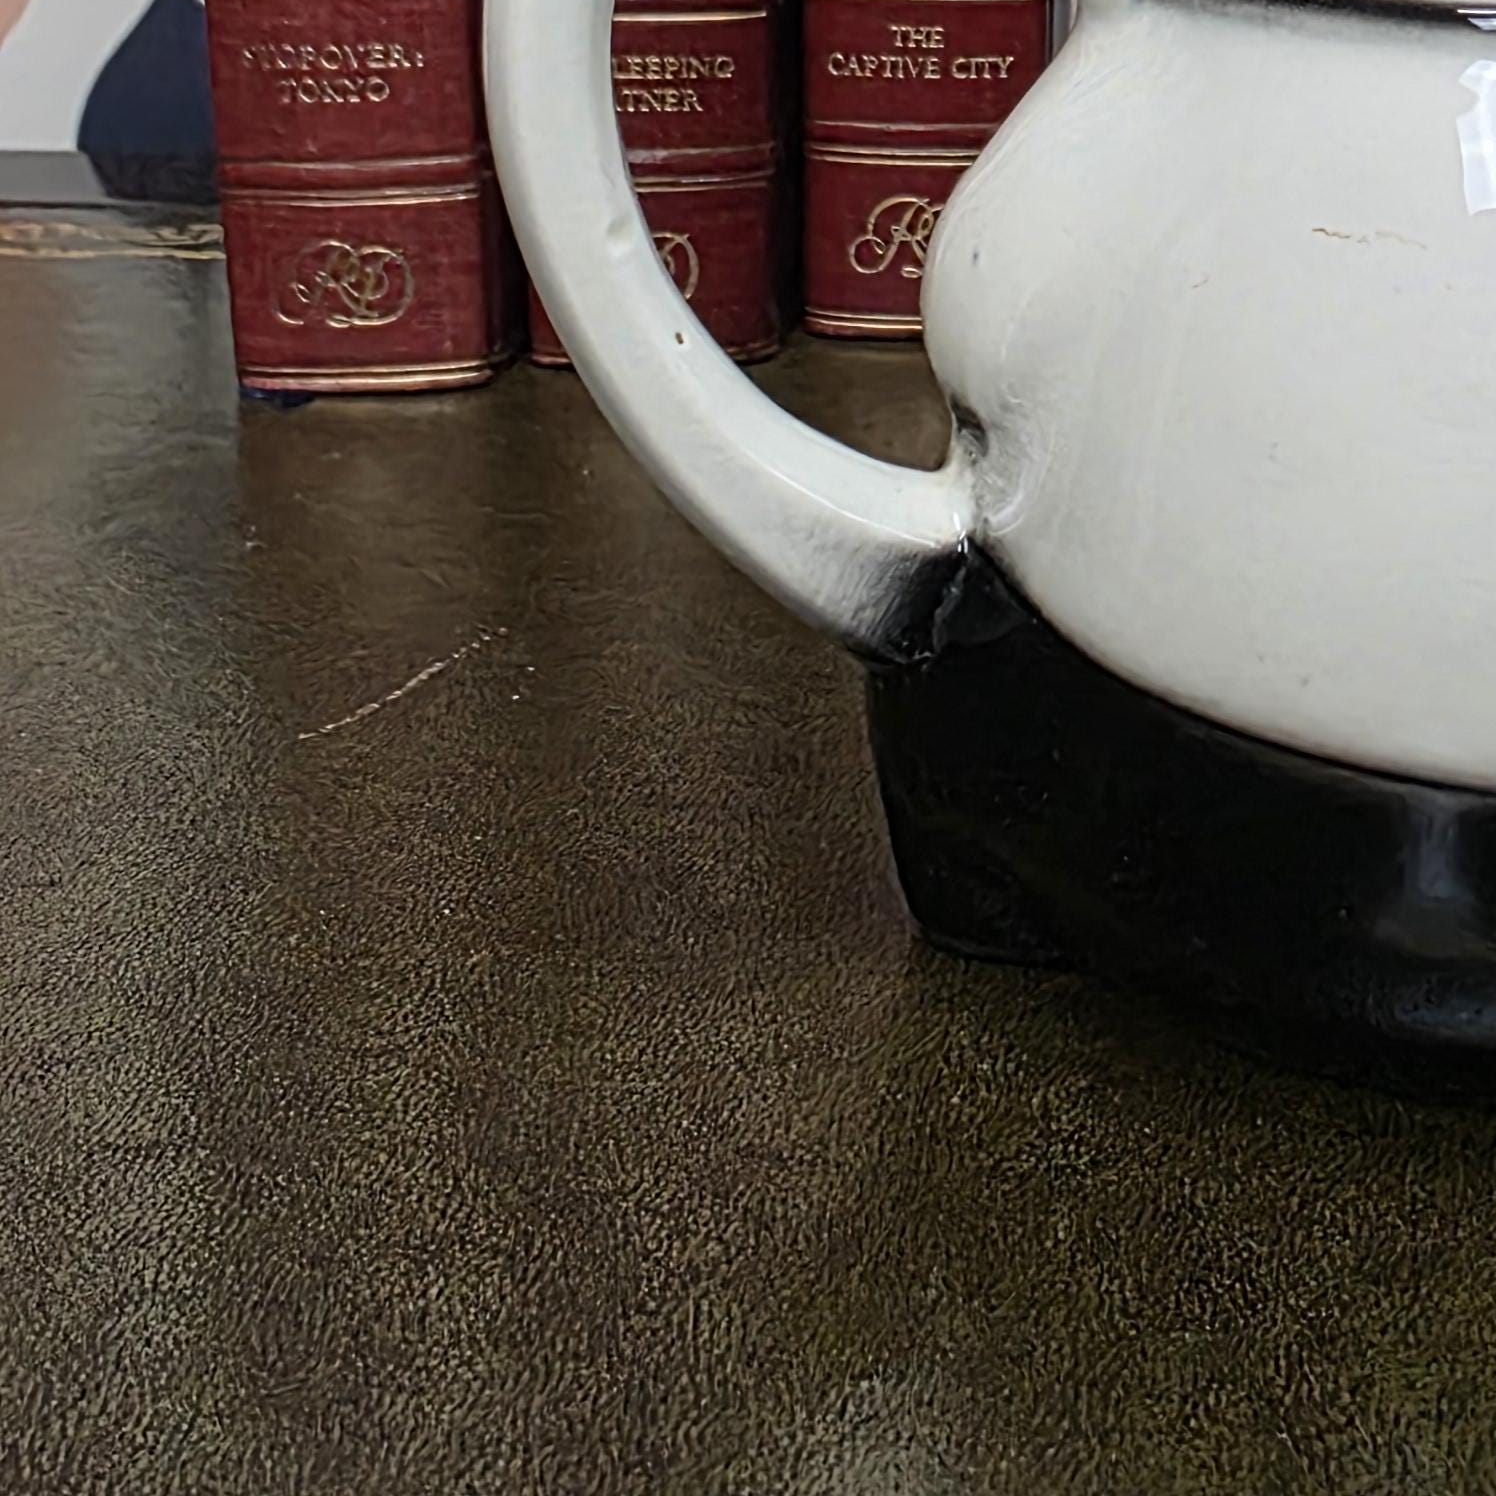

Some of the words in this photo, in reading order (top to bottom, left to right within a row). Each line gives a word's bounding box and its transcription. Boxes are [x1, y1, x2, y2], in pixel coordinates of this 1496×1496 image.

[889, 25, 945, 48] THE
[613, 55, 736, 80] LEEPING
[827, 51, 942, 79] CAPTIVE
[952, 56, 1015, 80] CITY
